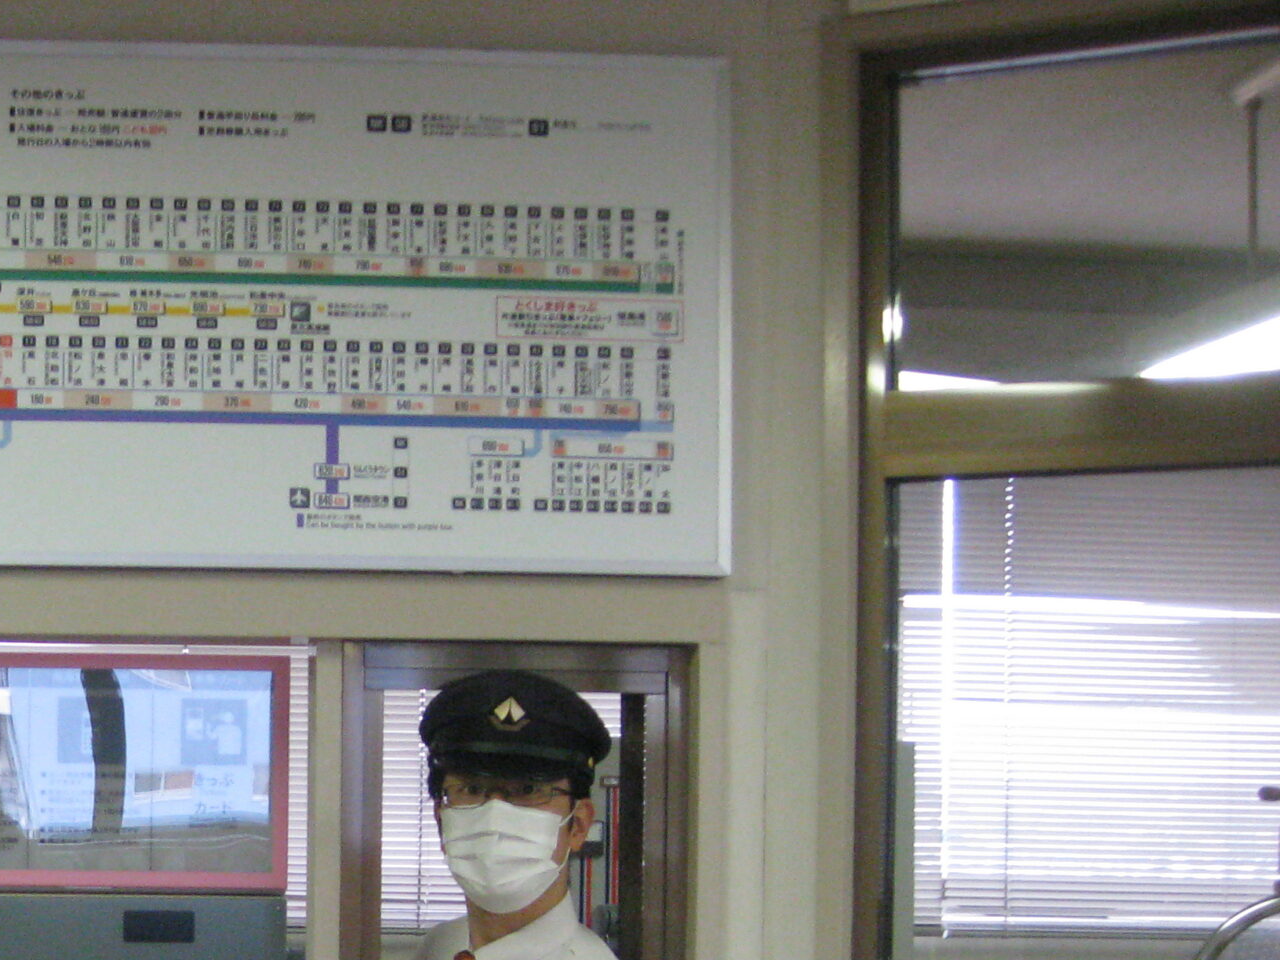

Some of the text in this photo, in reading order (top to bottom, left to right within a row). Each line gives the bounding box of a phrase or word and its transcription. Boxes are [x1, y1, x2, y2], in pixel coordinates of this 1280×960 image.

[11, 89, 85, 100] その他のきっぷ
[194, 772, 235, 787] きっぷ
